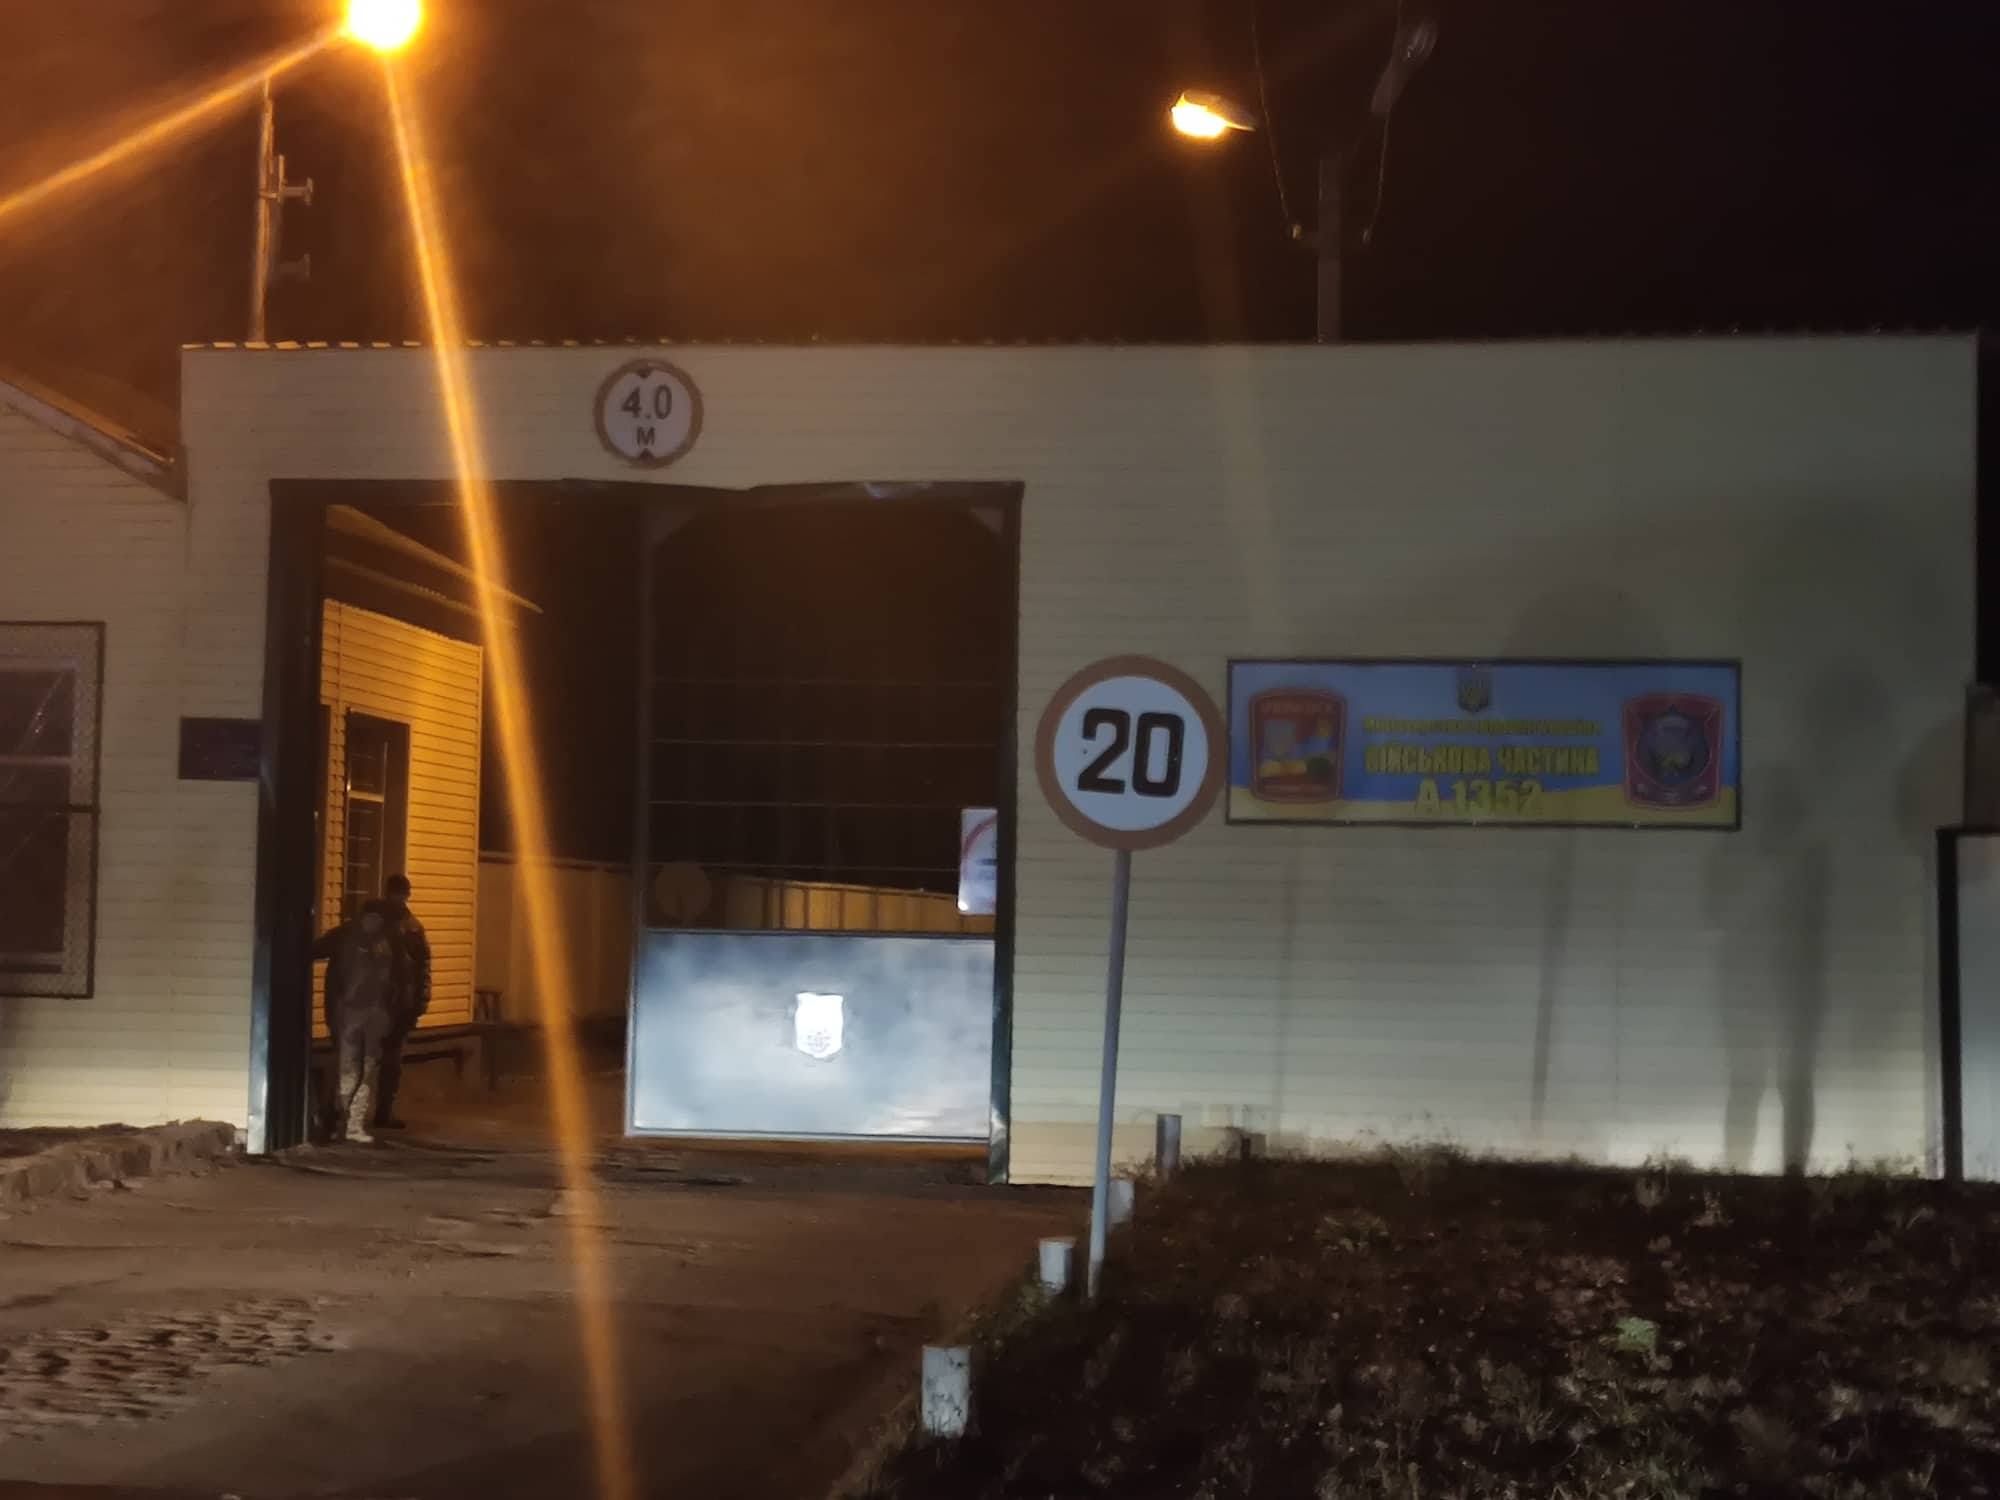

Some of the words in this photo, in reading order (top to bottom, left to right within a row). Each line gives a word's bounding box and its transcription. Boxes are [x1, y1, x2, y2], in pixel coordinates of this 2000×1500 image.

[1077, 708, 1185, 798] 20
[1364, 742, 1492, 775] ВІЙСЬКОВА
[1497, 745, 1600, 776] ЧАСТИНА
